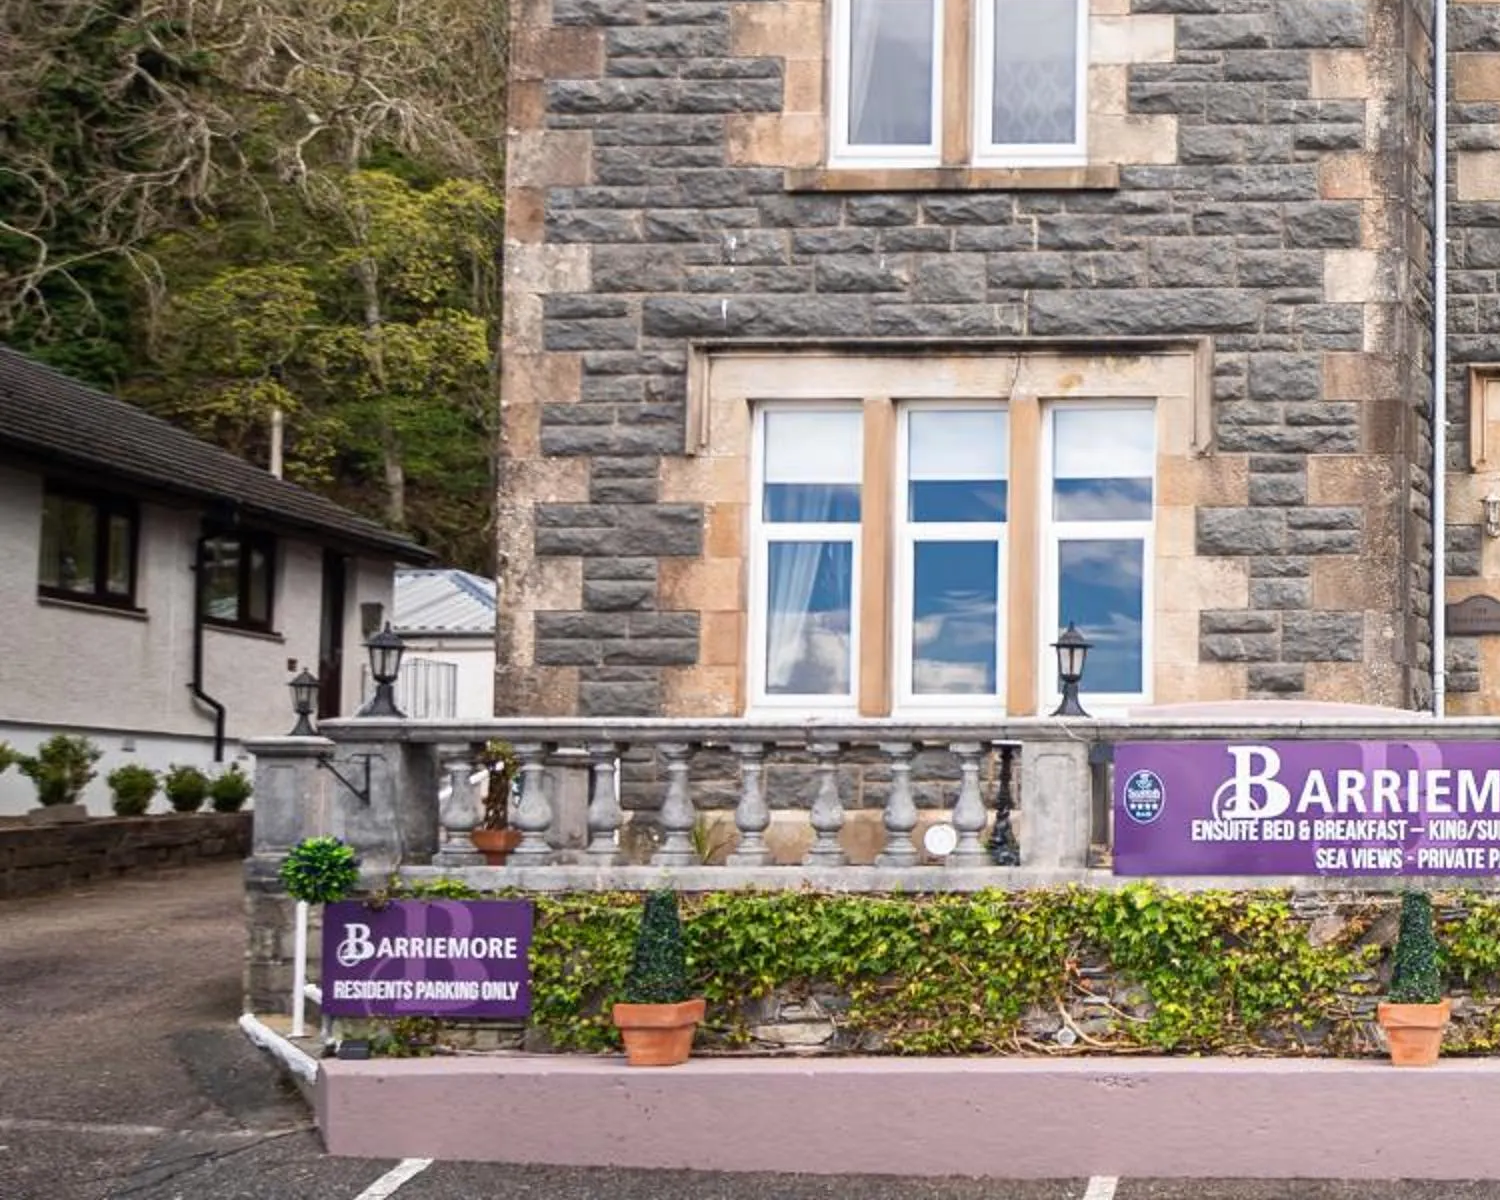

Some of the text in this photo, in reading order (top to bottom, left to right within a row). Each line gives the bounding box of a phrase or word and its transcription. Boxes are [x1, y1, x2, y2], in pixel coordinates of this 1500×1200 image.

[1191, 819, 1259, 841] ENSUITE
[1262, 819, 1295, 841] BED
[1299, 819, 1311, 841] &
[1313, 819, 1408, 841] BREAKFAST
[1315, 847, 1349, 869] SEA
[1351, 847, 1403, 869] VIEWS
[1418, 847, 1486, 869] PRIVATE
[336, 923, 517, 967] BARRIEMORE
[333, 980, 519, 1000] RESIDENTS PARKING ONLY
